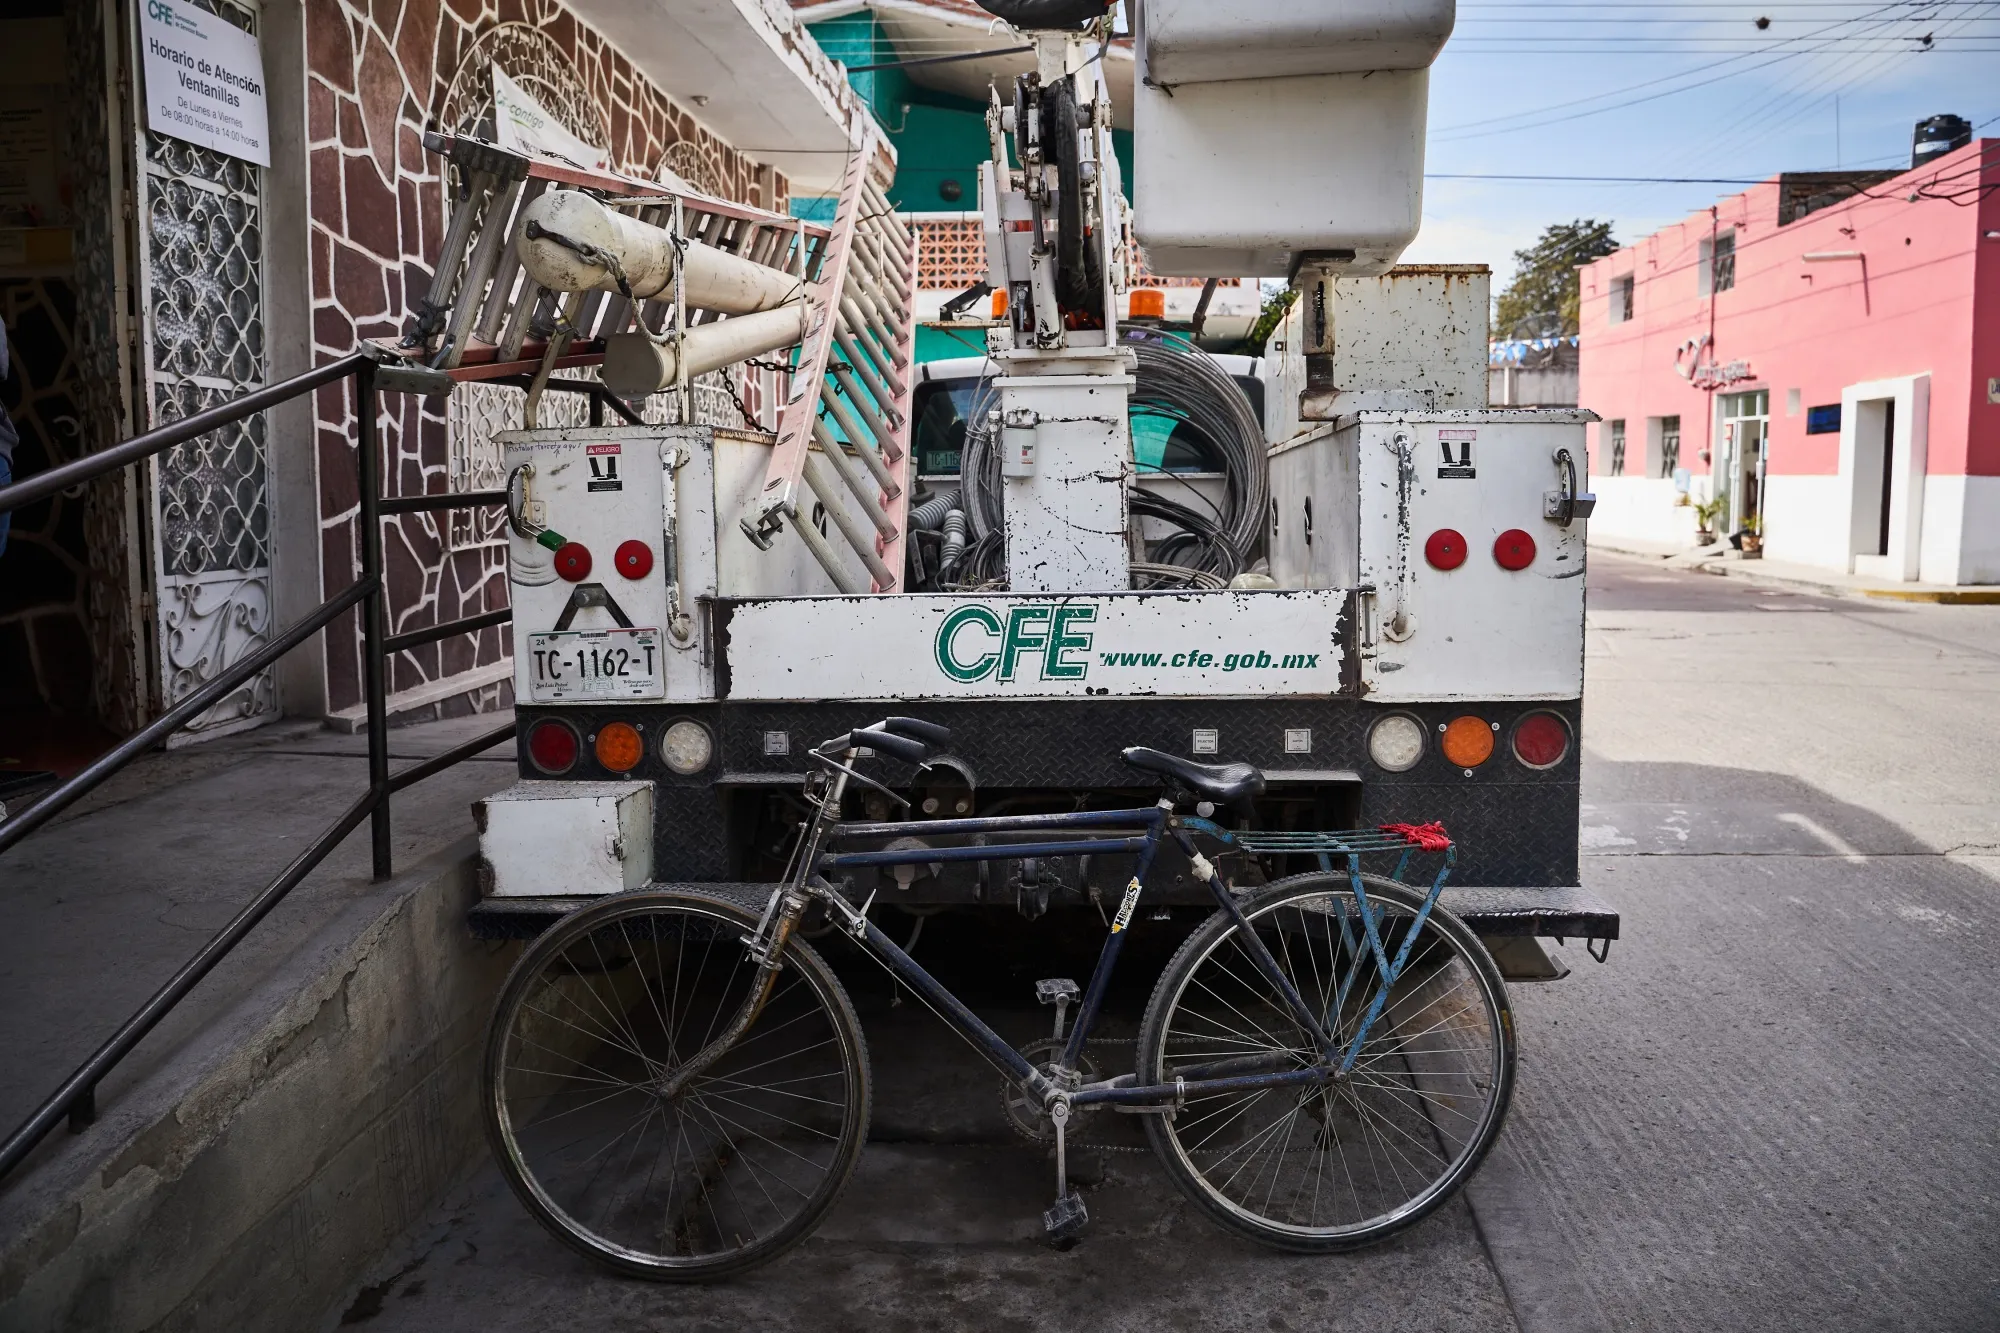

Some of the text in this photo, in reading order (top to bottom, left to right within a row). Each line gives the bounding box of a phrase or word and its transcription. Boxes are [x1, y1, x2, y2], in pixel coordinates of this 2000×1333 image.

[148, 0, 173, 27] CFE
[149, 37, 261, 96] Horario de Atención
[178, 70, 240, 108] Ventanillas
[161, 105, 259, 149] De 08:00 horas a 14:00 horas
[177, 96, 243, 129] De Lunes a Viernes
[933, 603, 1321, 684] CFE www.cfe.gob.mx
[533, 645, 656, 681] TC-1162-T
